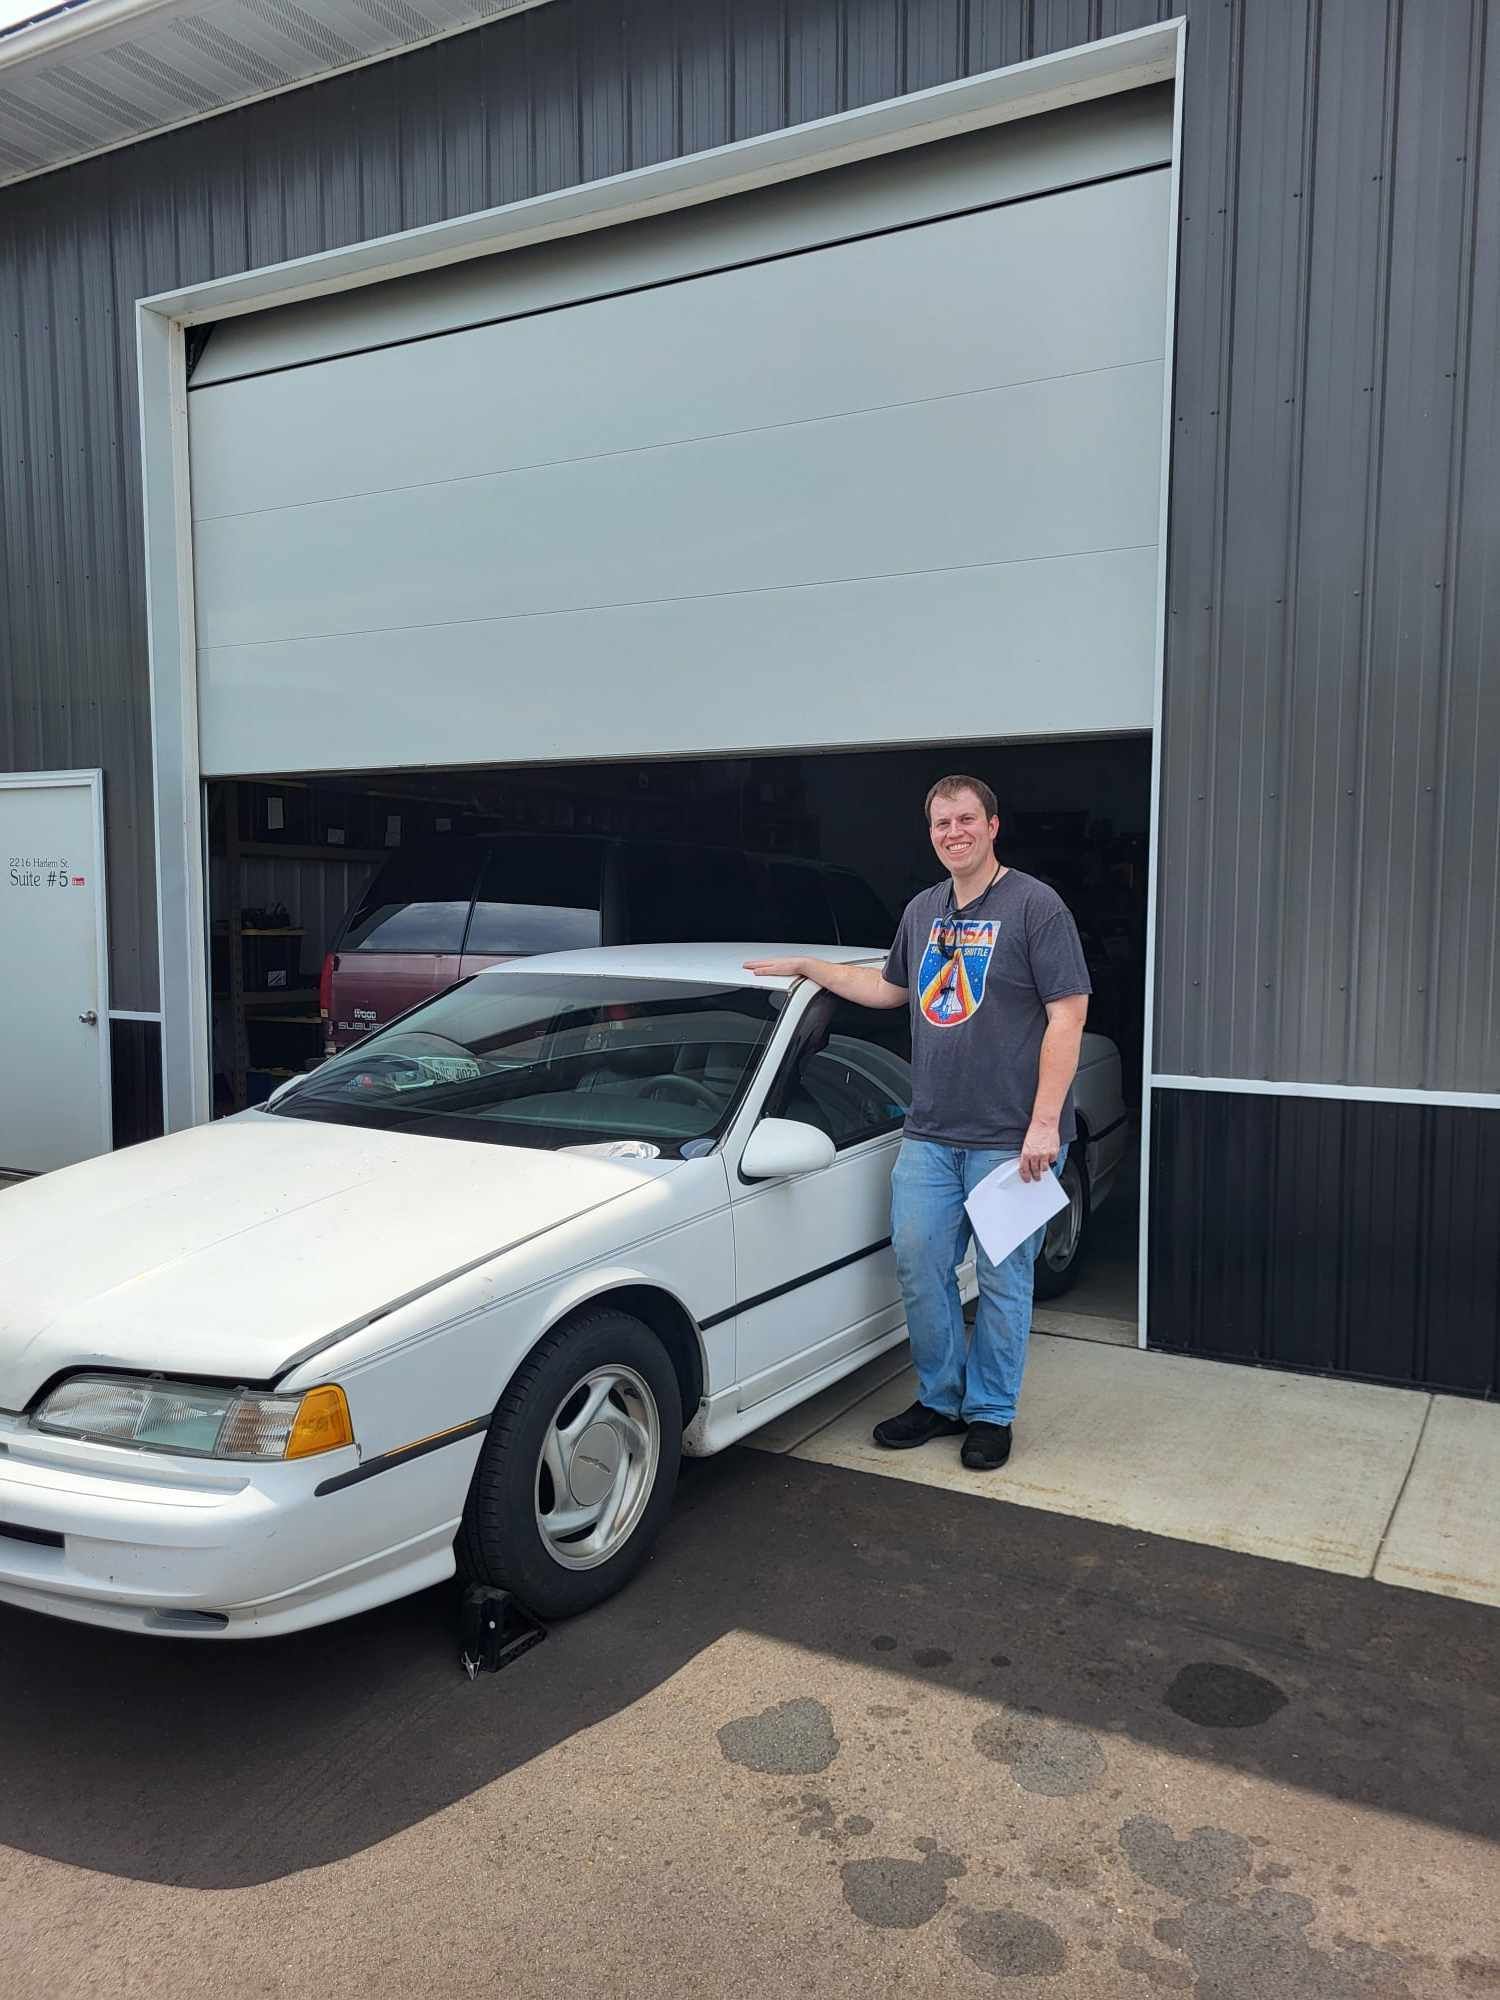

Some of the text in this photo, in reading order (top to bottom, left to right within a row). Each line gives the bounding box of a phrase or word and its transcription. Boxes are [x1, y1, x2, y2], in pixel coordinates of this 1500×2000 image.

[9, 857, 31, 867] 2216
[10, 868, 41, 887] Suite
[47, 870, 69, 888] #5
[964, 947, 989, 957] SHUTTLE
